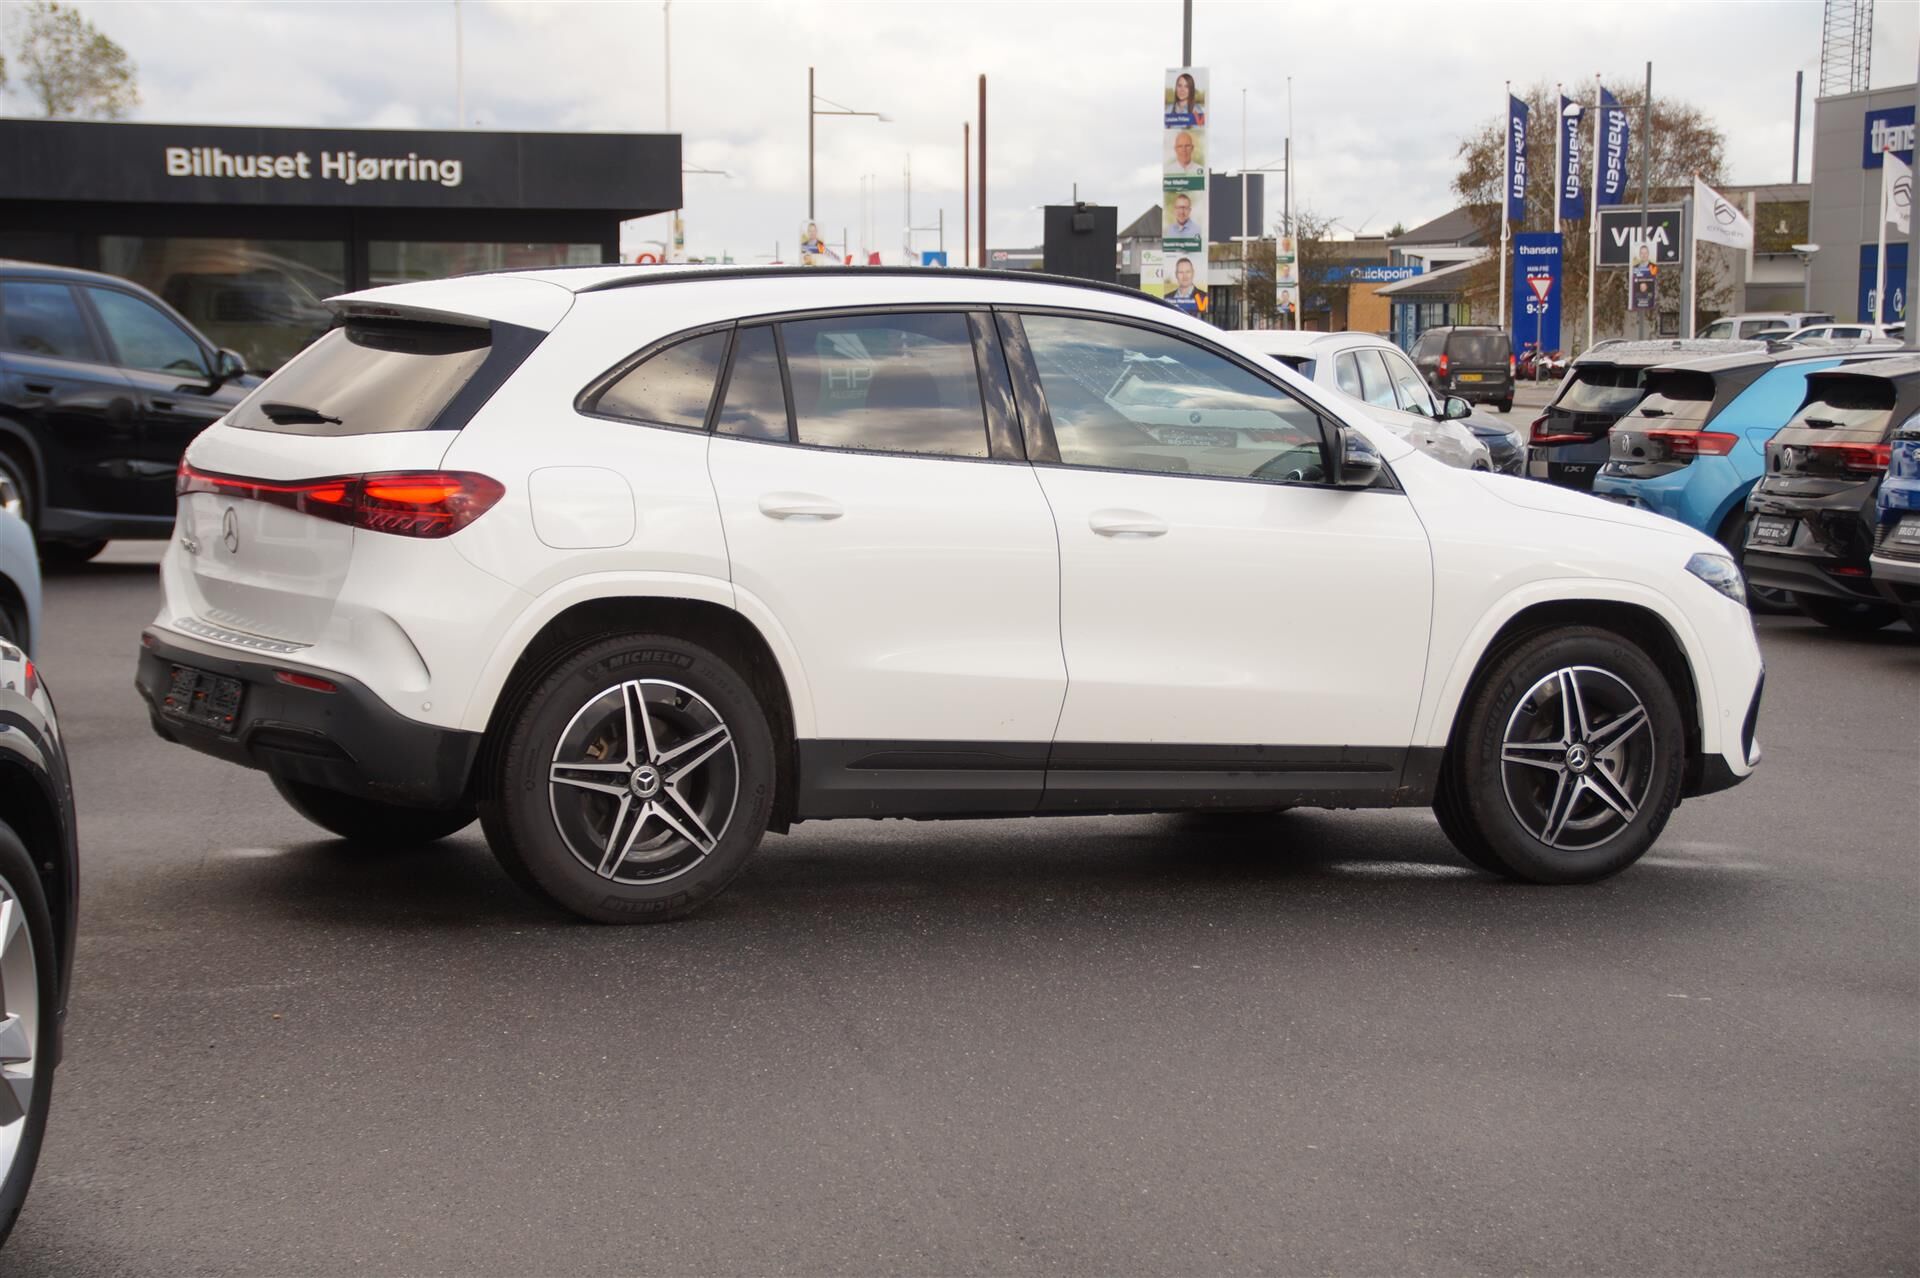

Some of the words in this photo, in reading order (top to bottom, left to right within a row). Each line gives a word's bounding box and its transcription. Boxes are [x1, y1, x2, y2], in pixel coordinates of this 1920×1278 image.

[1565, 118, 1581, 199] thansen
[1605, 110, 1626, 194] thansen
[166, 148, 312, 179] Bilhuset
[321, 151, 463, 187] Hjørring
[1611, 226, 1669, 247] VIKA
[1519, 245, 1558, 255] thansen
[1351, 267, 1413, 281] Quickpoint
[608, 651, 691, 667] MICHELIN
